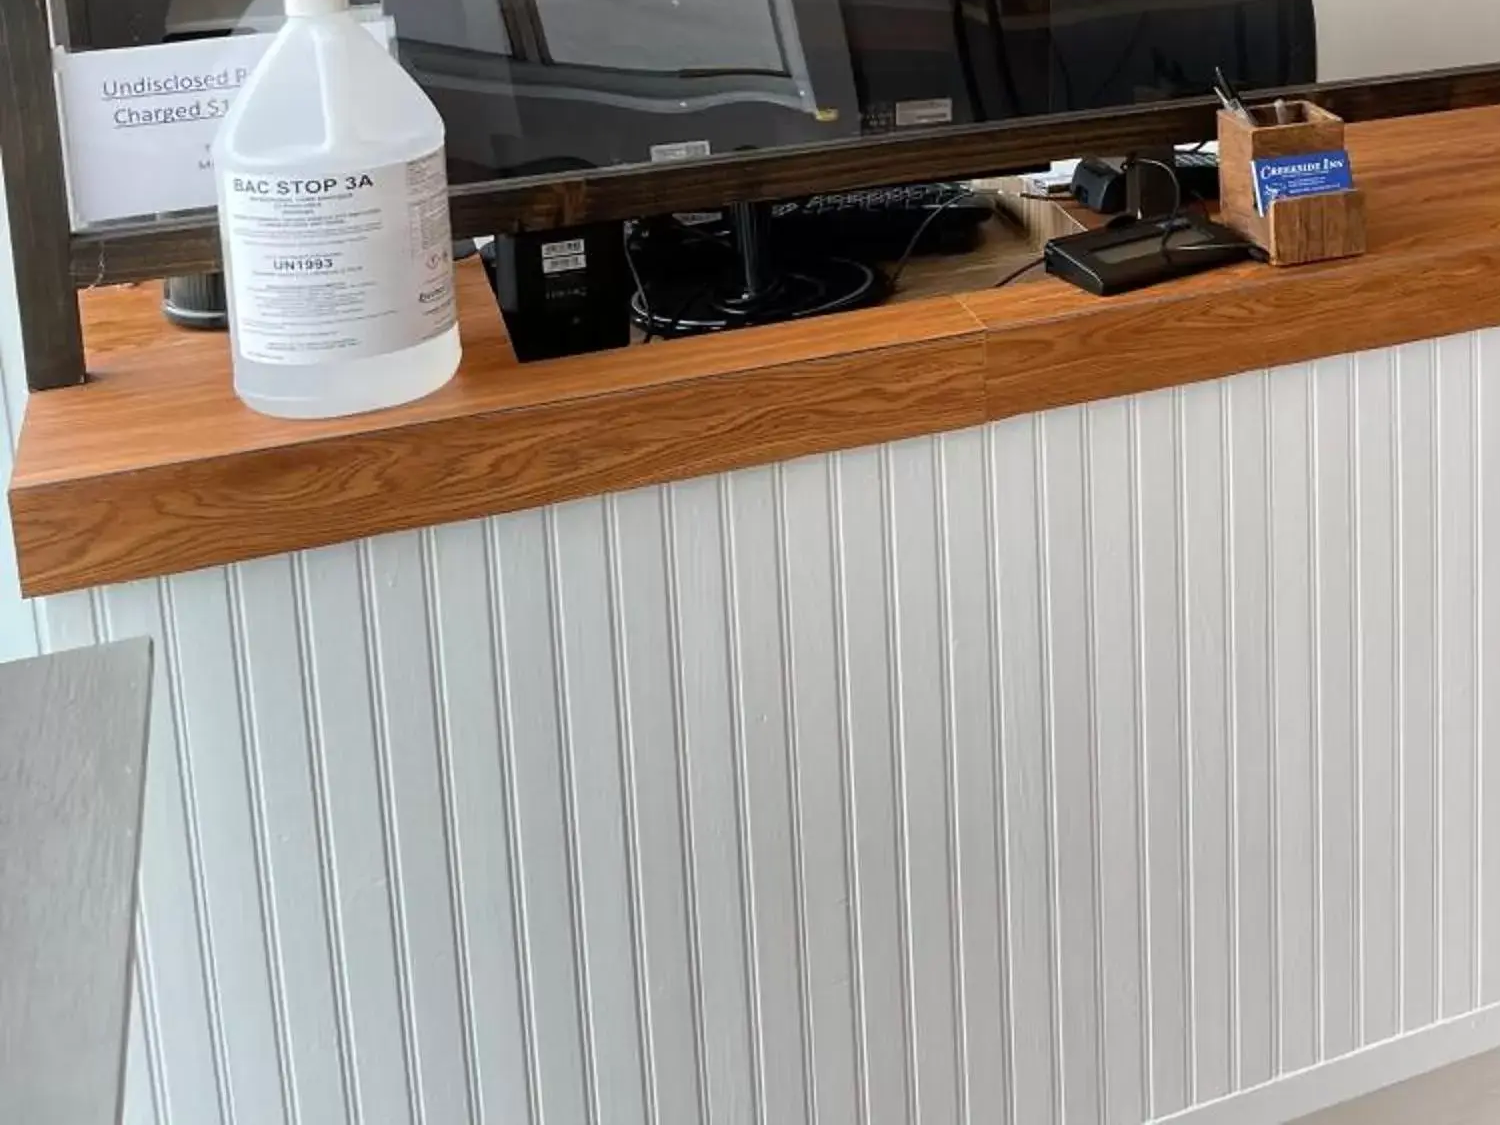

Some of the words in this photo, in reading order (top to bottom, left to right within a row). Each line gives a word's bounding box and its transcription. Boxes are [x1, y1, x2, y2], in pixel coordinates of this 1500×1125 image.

[102, 67, 229, 99] Undisclosed
[113, 101, 201, 126] Charged
[233, 178, 270, 194] BAC
[276, 178, 338, 195] STOP
[345, 174, 374, 191] 3A
[273, 258, 334, 271] UN1993
